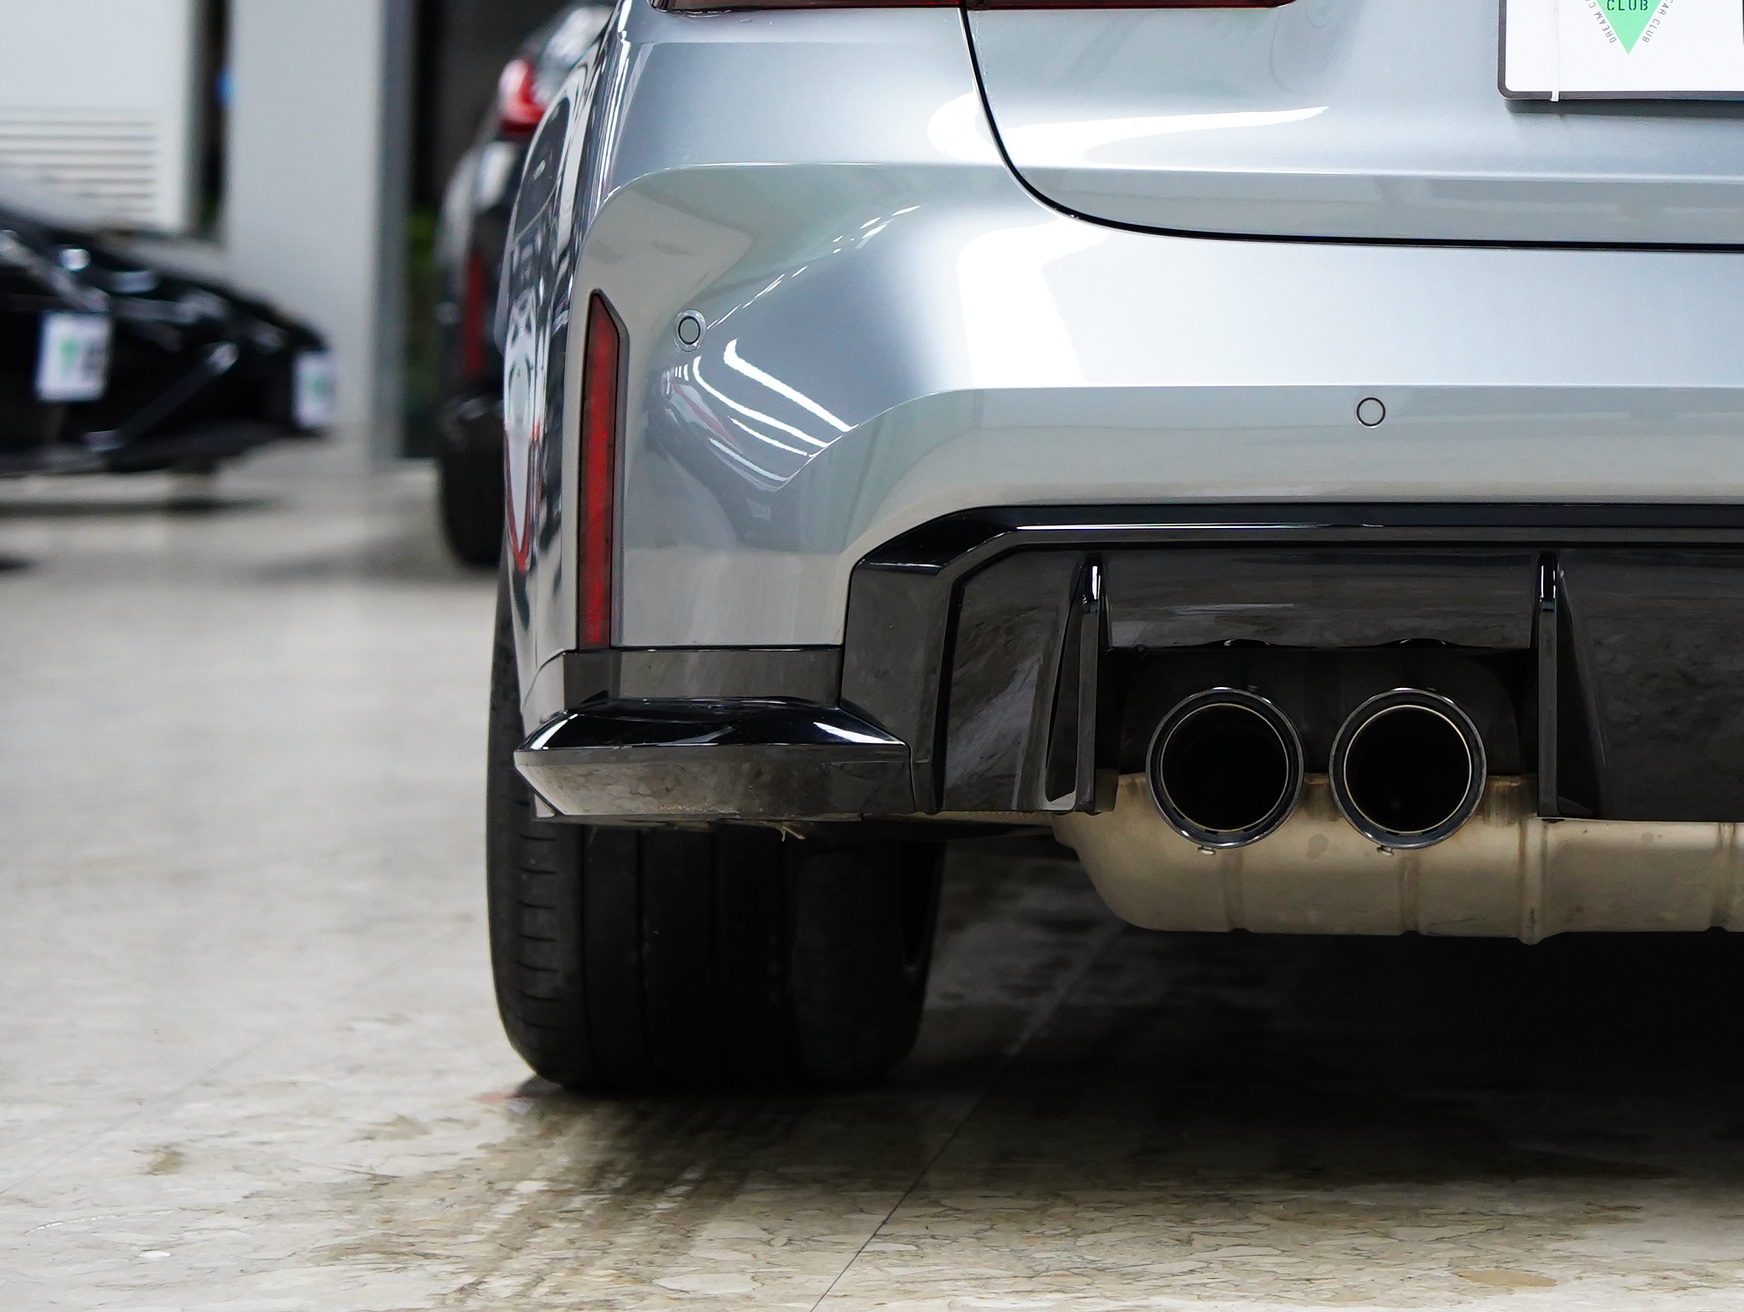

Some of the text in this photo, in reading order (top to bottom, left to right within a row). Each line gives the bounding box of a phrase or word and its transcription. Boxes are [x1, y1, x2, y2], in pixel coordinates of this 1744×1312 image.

[1606, 0, 1648, 11] CLUB
[1594, 11, 1617, 44] DREAM
[1641, 18, 1661, 43] CLUB
